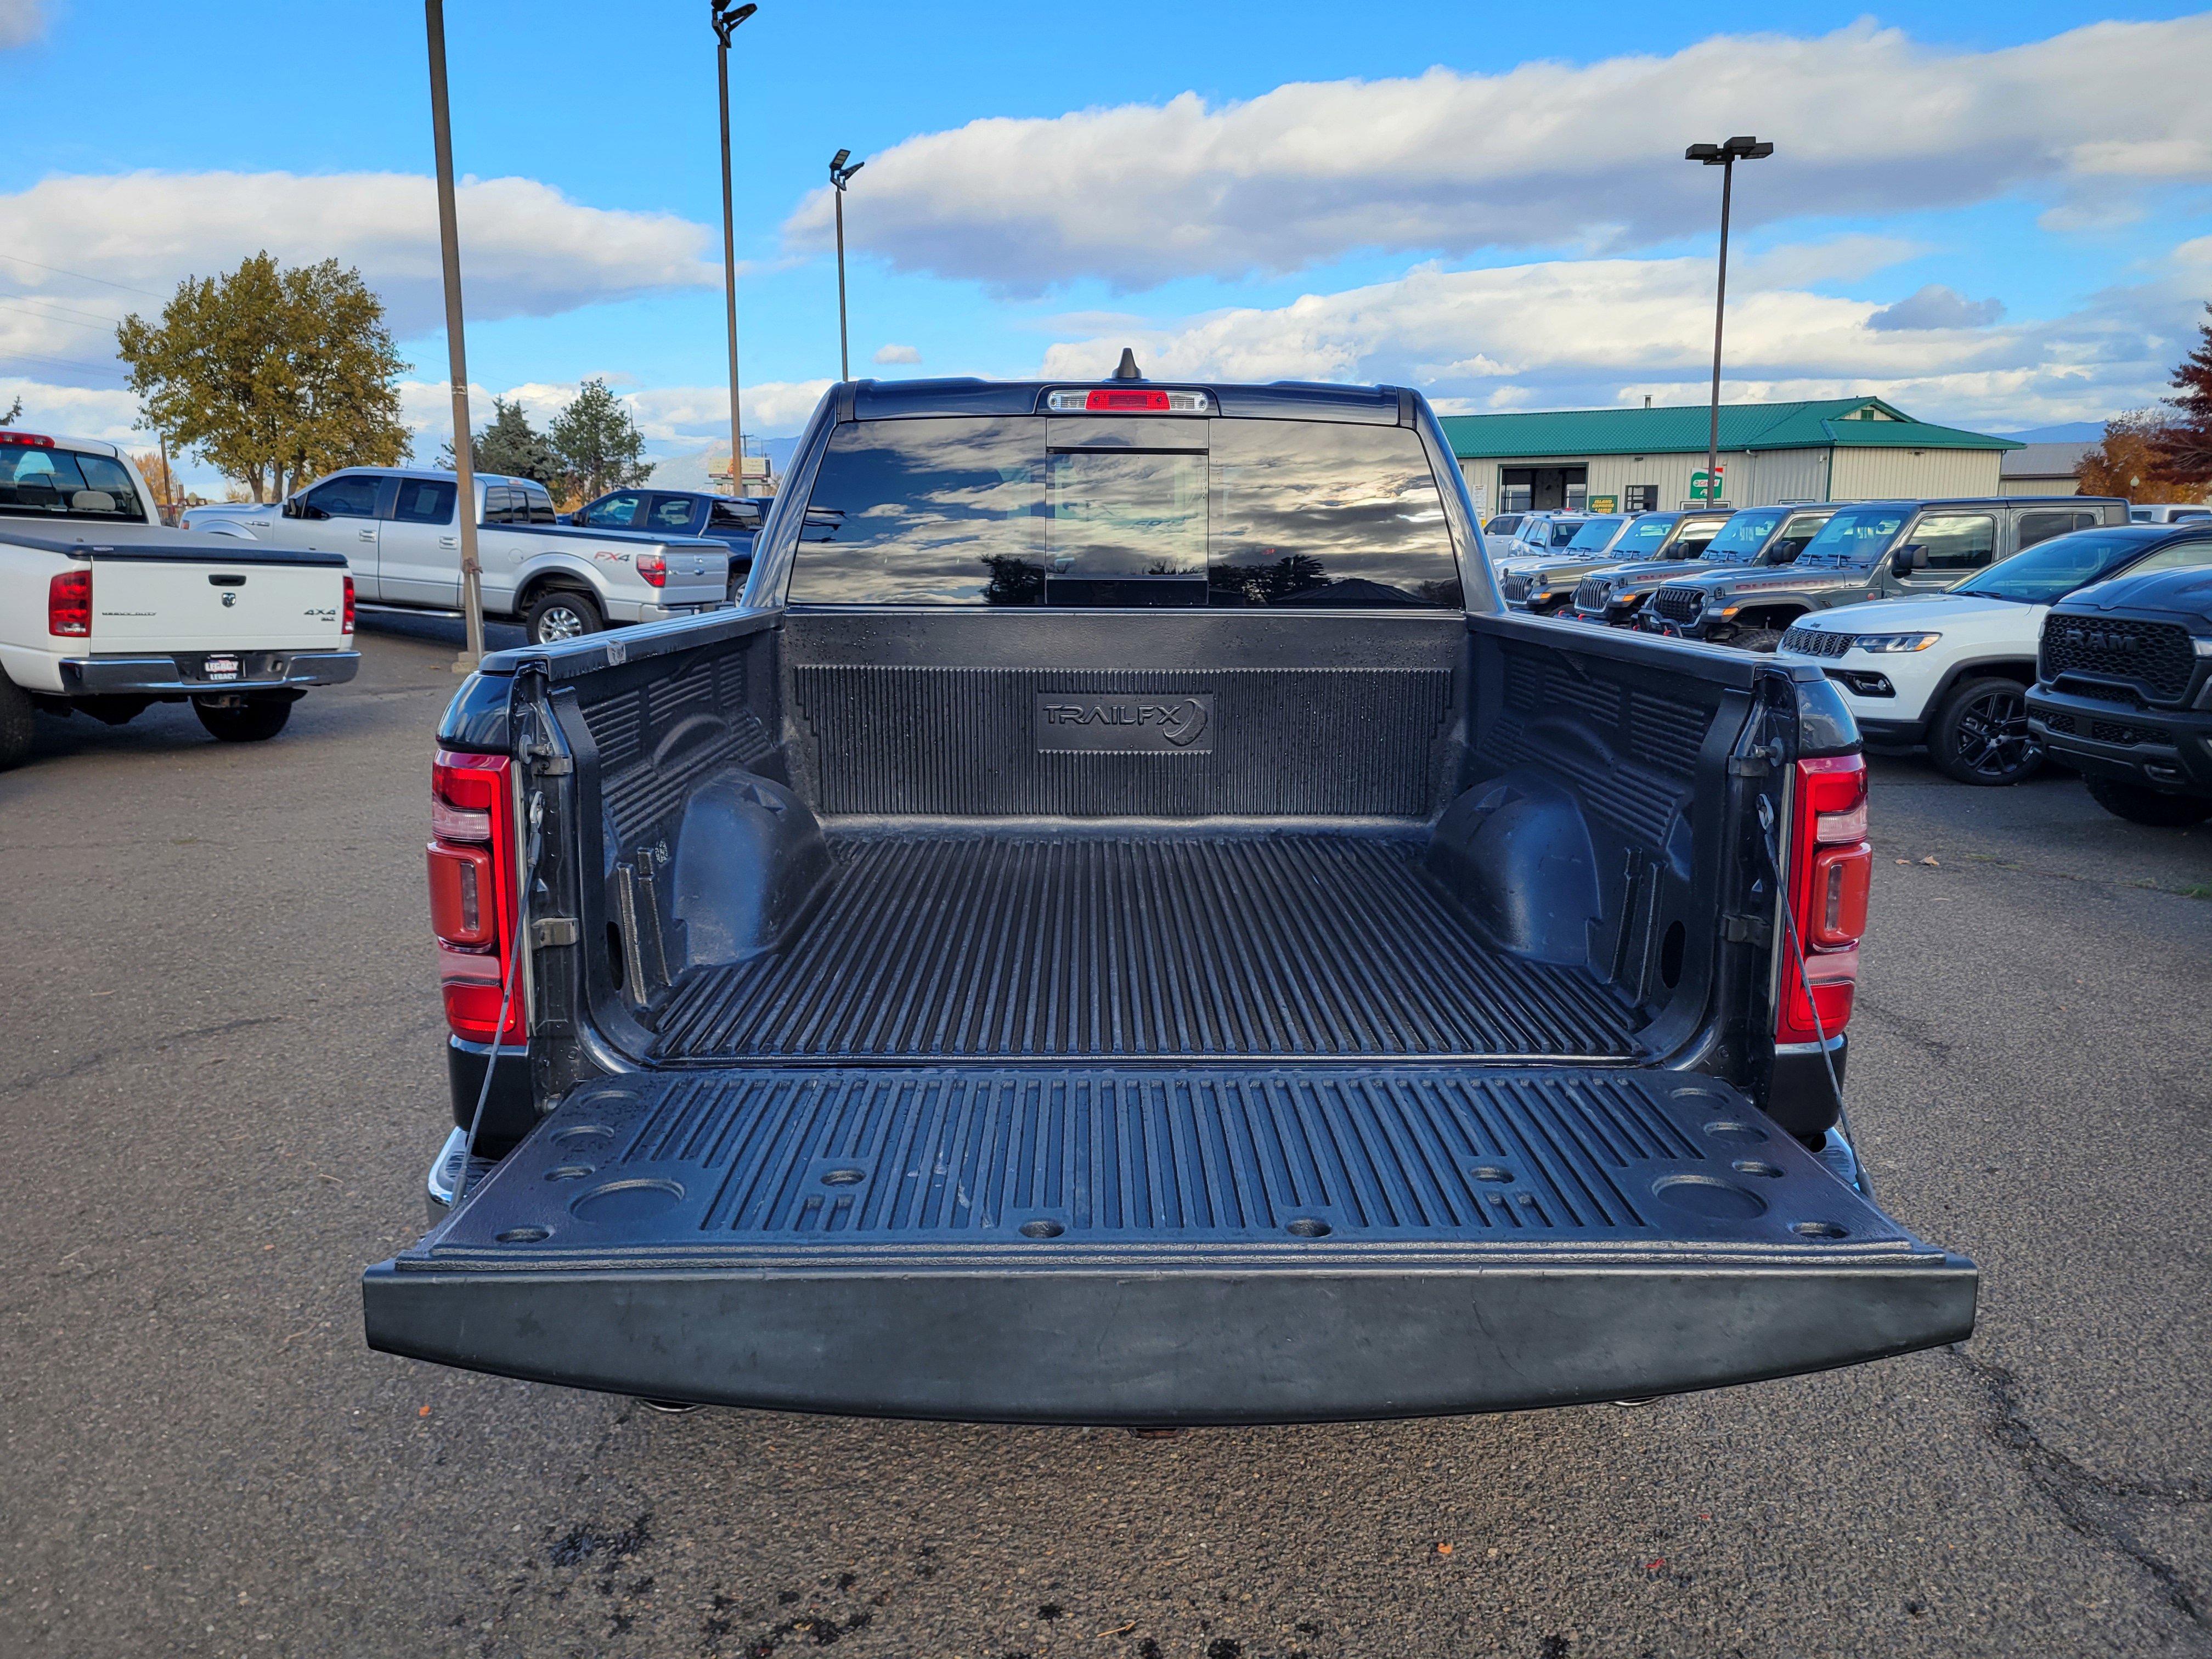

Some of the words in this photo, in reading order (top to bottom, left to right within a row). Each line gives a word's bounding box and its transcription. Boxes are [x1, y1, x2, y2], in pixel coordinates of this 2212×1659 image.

[594, 551, 630, 561] FX4
[1735, 579, 1835, 591] RUBICON
[2066, 630, 2140, 652] RAM
[205, 661, 239, 672] LEGACY
[1043, 704, 1181, 725] TRAILFX
